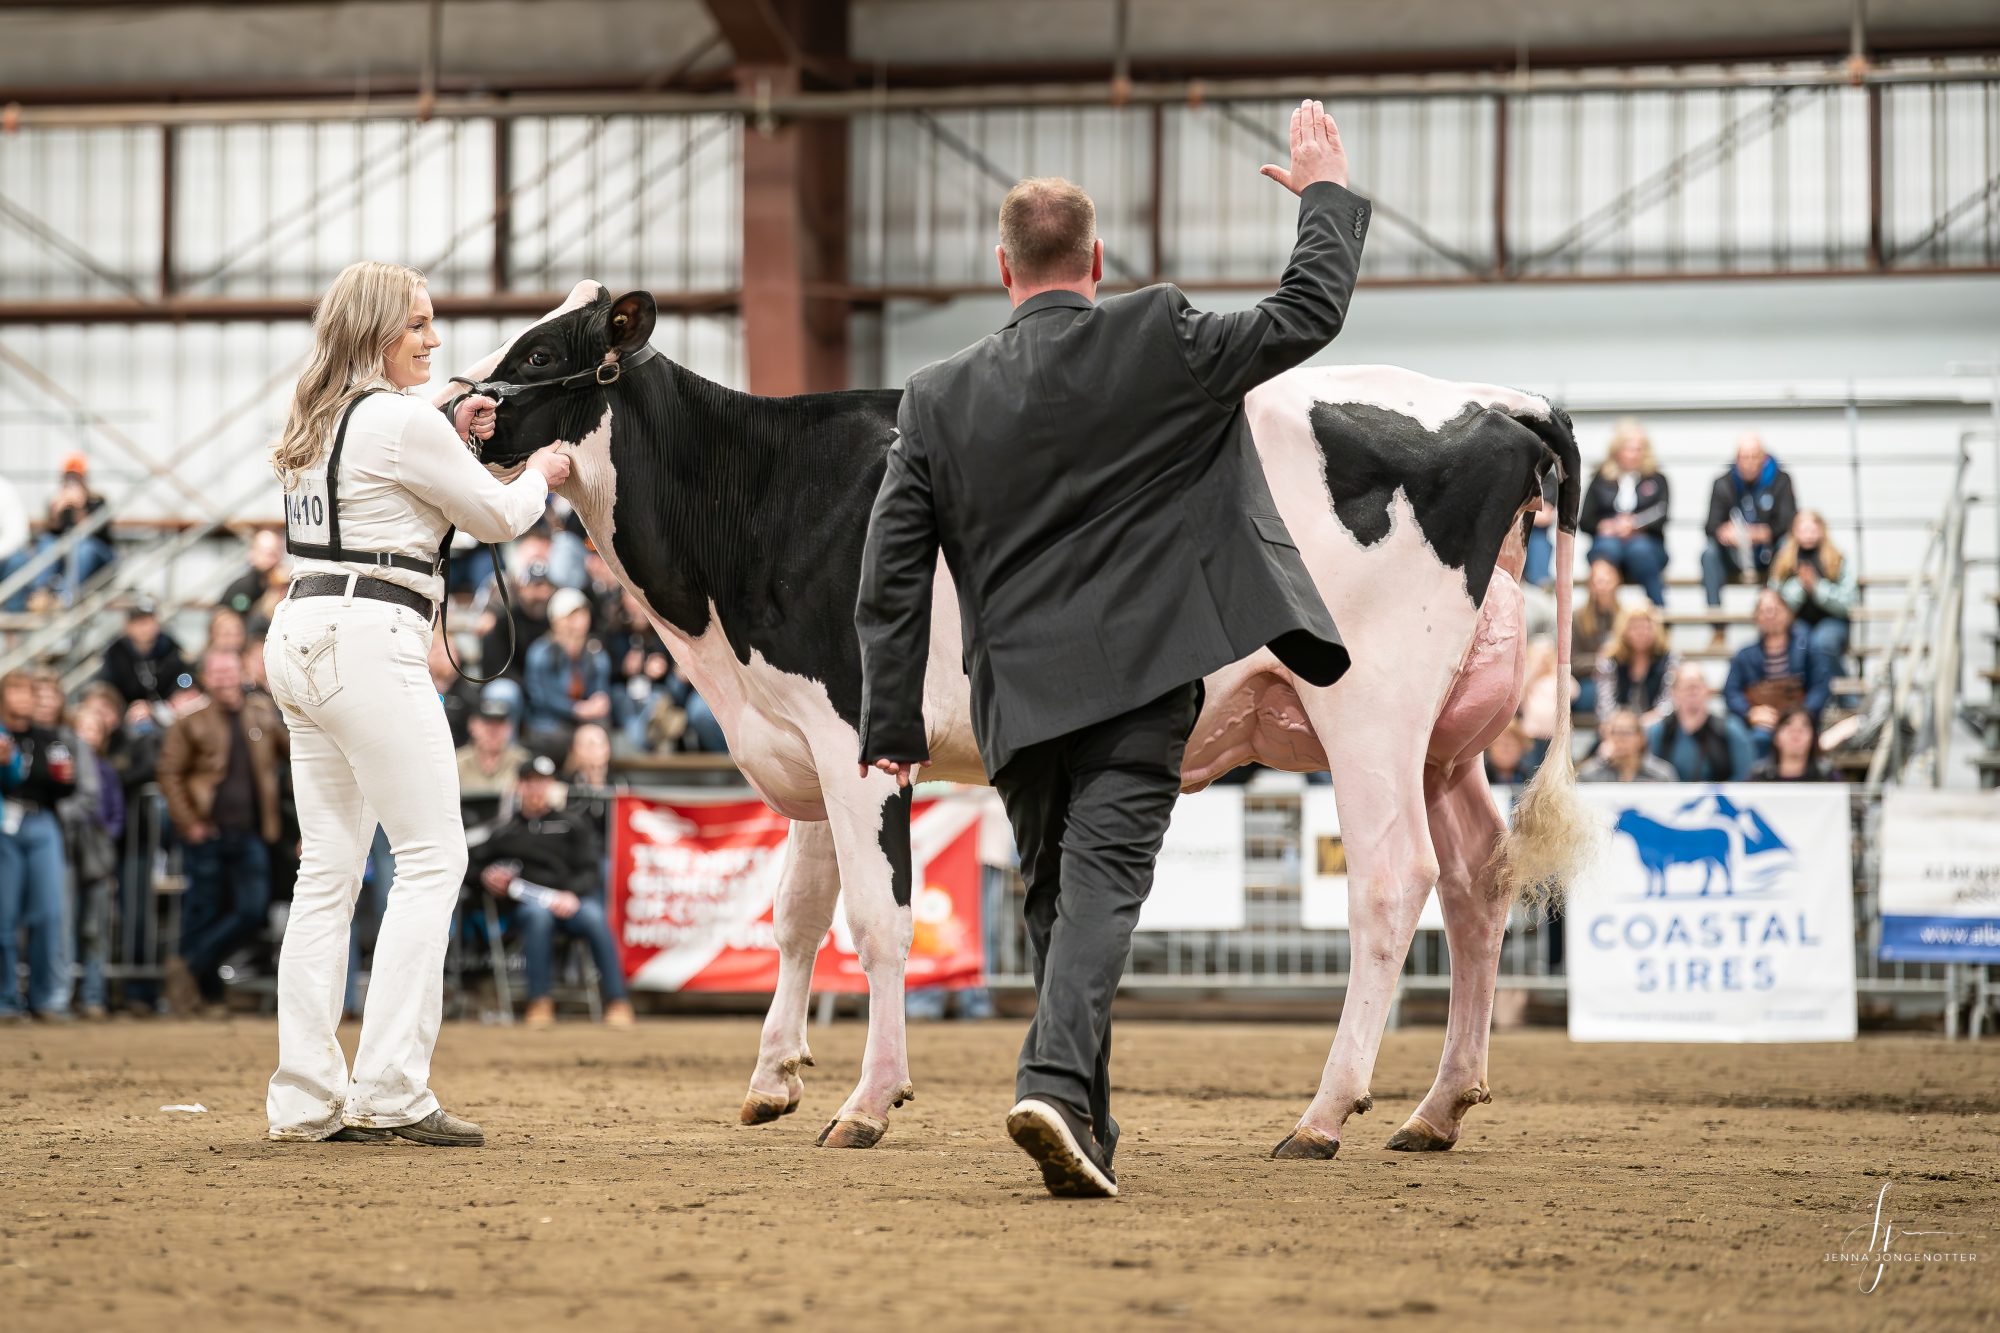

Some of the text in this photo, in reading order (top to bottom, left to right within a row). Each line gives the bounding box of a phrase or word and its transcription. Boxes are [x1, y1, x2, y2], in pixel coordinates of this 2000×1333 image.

[288, 494, 324, 526] 1410
[1588, 910, 1821, 950] COASTAL
[1636, 955, 1776, 993] SIRES
